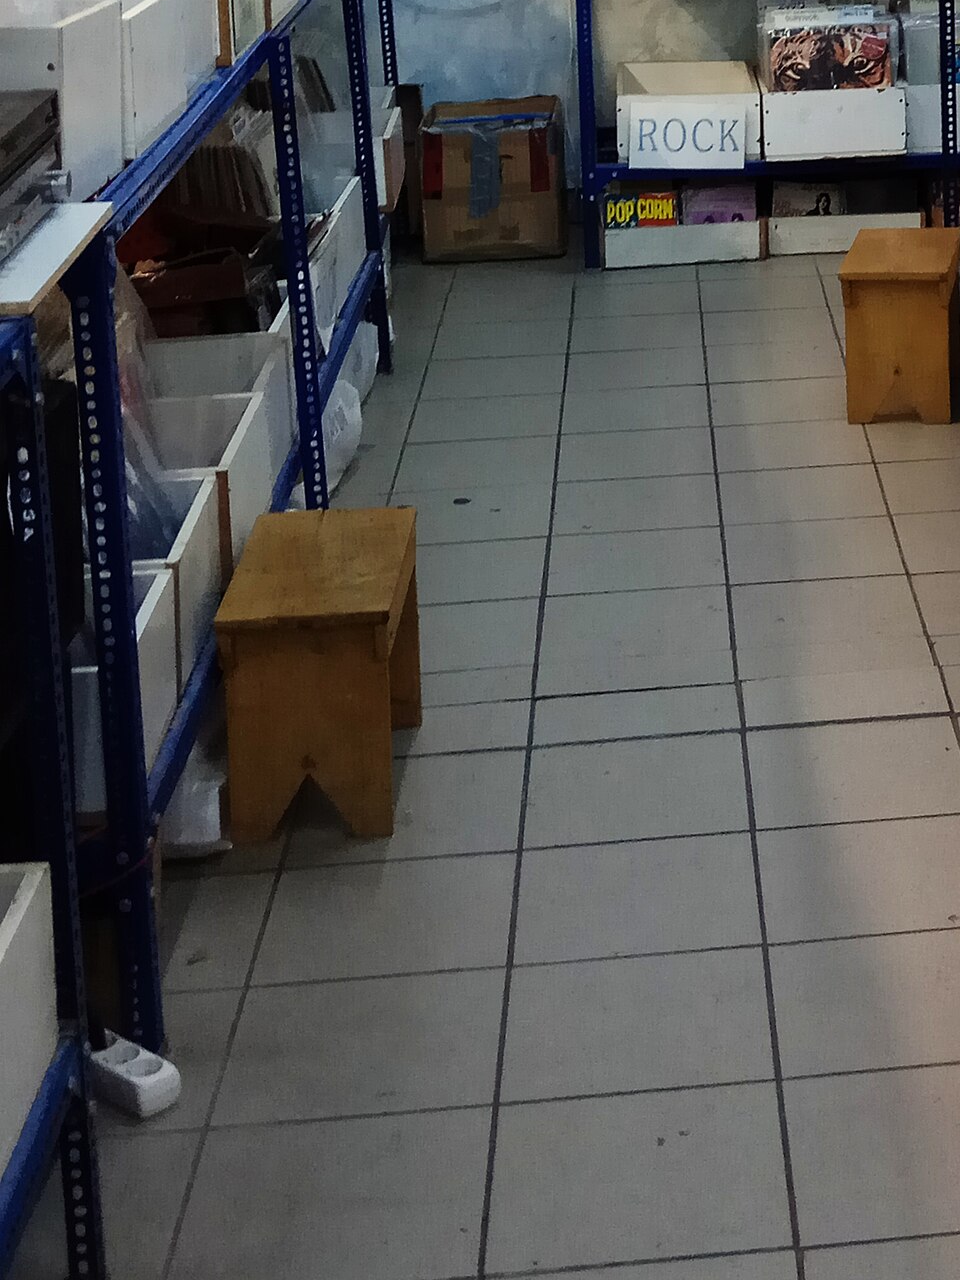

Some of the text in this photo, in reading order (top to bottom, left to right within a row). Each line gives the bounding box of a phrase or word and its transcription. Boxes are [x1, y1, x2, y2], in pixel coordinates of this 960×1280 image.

[637, 117, 740, 153] ROCK
[606, 198, 674, 224] POP CORN
